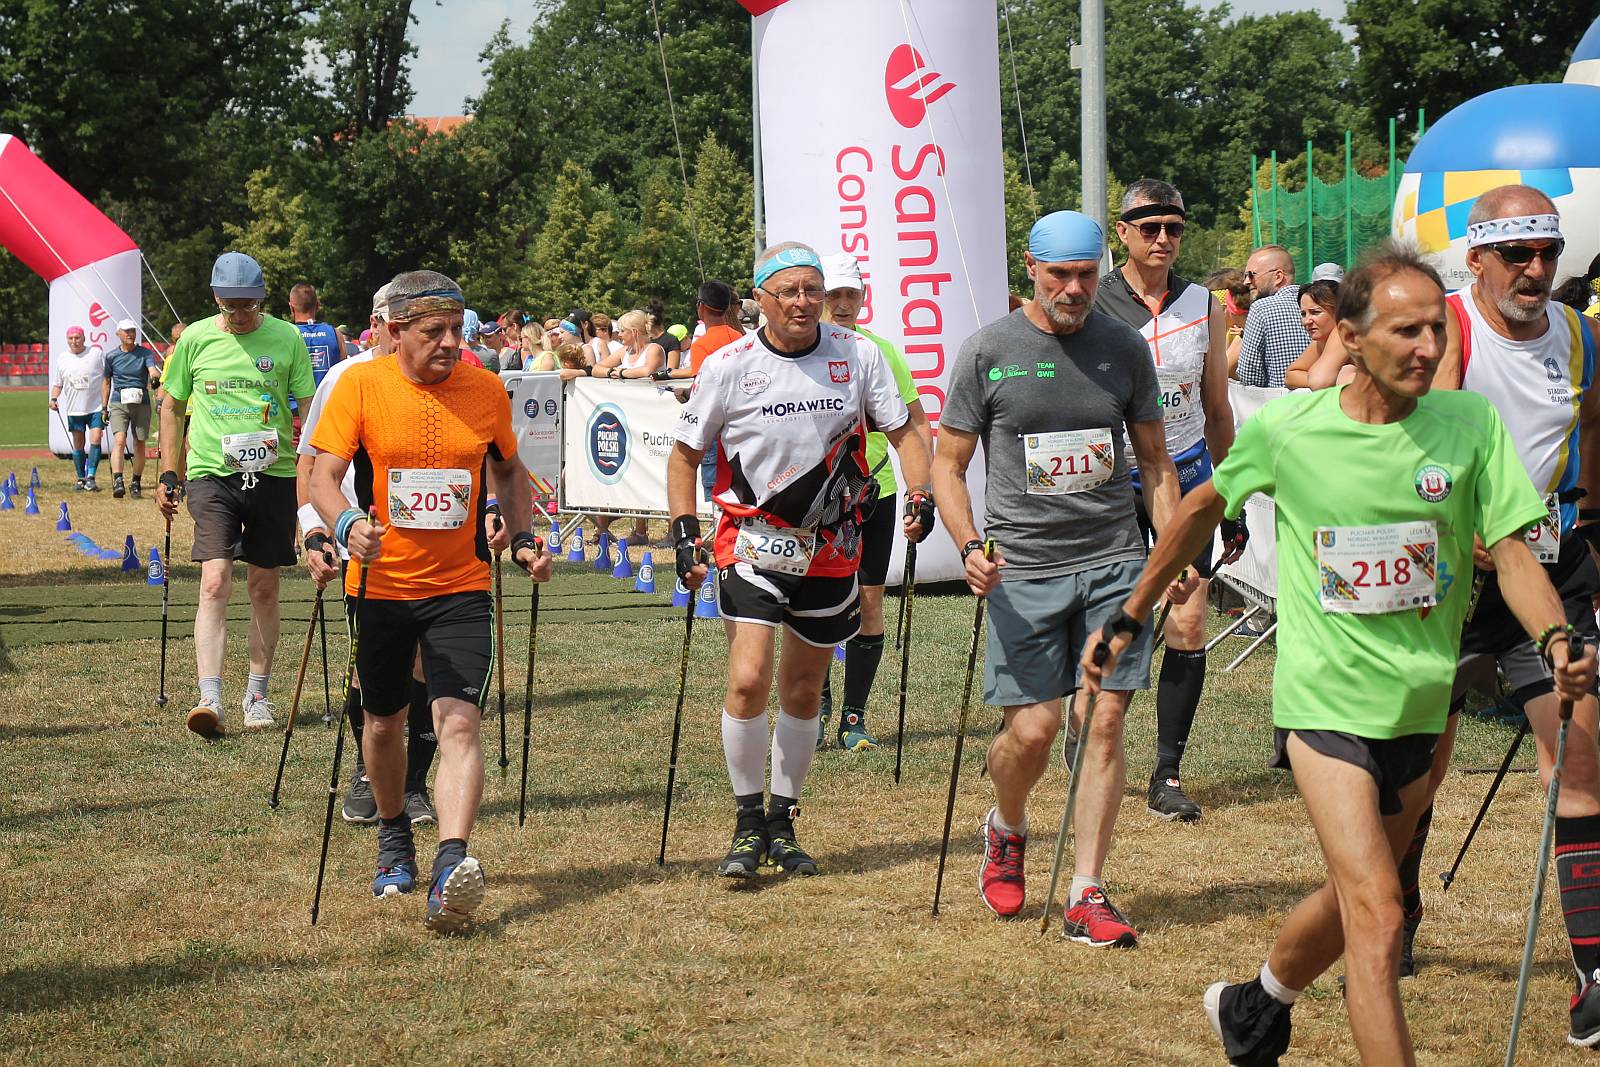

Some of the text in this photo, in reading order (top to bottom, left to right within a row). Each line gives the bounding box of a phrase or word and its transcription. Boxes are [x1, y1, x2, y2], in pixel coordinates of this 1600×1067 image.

[891, 143, 952, 437] Santand
[219, 380, 278, 389] METRACO
[762, 398, 844, 416] MORAWIEC
[1162, 391, 1182, 408] 46
[597, 431, 619, 441] PUCHAR
[238, 447, 267, 462] 290
[597, 440, 619, 452] POLSKI
[1050, 454, 1093, 476] 211
[411, 492, 452, 511] 205
[1528, 523, 1542, 542] 9
[757, 535, 797, 557] 268
[1352, 558, 1411, 587] 218
[462, 686, 480, 695] 4F
